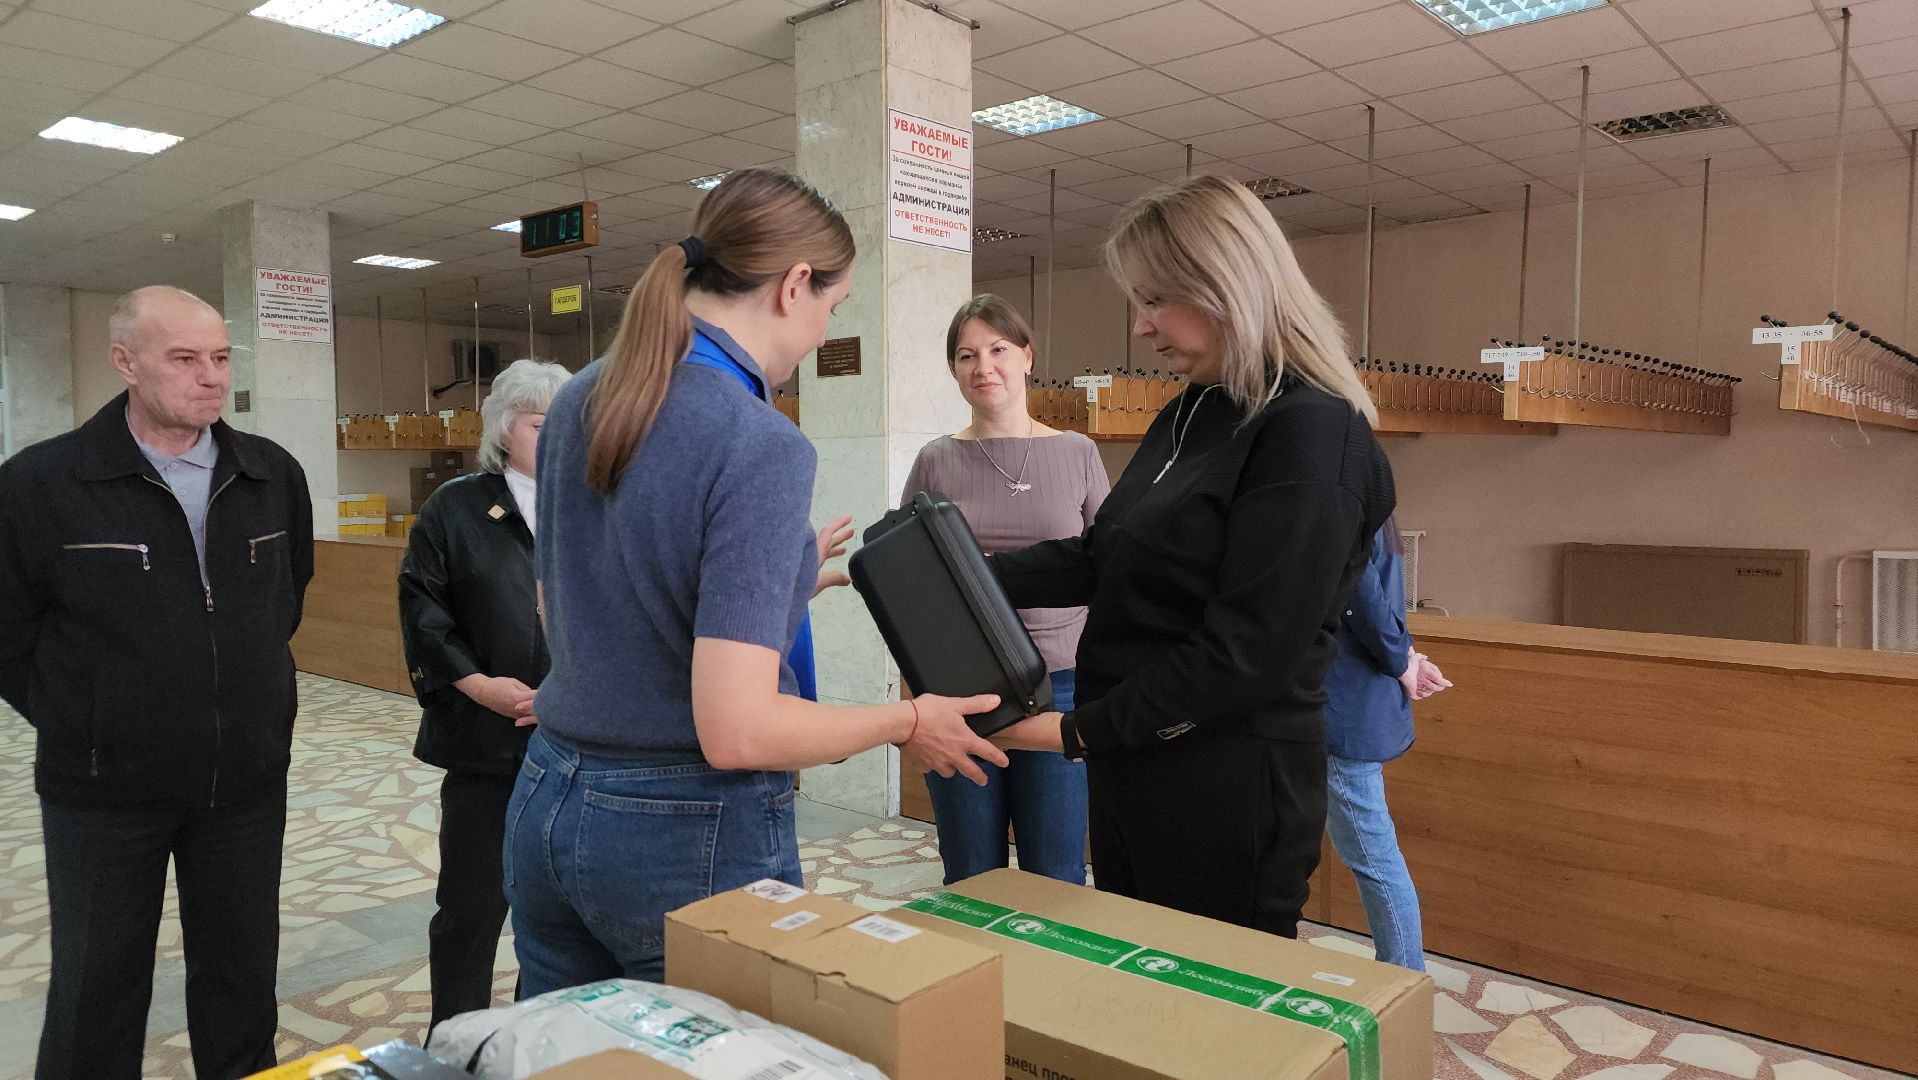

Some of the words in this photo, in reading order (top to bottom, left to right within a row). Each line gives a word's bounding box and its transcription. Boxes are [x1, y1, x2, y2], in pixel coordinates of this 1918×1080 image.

[893, 116, 969, 149] УВАЖАЕМЫЕ
[911, 139, 952, 162] ГОСТИ!
[892, 191, 970, 217] АДМИНИСТРАЦИЯ
[894, 209, 968, 232] ОТВЕТСТВЕННОСТЬ
[912, 224, 925, 234] НЕ
[925, 226, 951, 239] НЕСЕТ!
[260, 271, 327, 286] УВАЖАЕМЫЕ
[276, 283, 313, 294] ГОСТИ!
[260, 312, 329, 324] АДМИНИСТРАЦИЯ
[262, 322, 328, 332] ОТВЕТСТВЕННОСТЬ
[1005, 1053, 1038, 1078] анец
